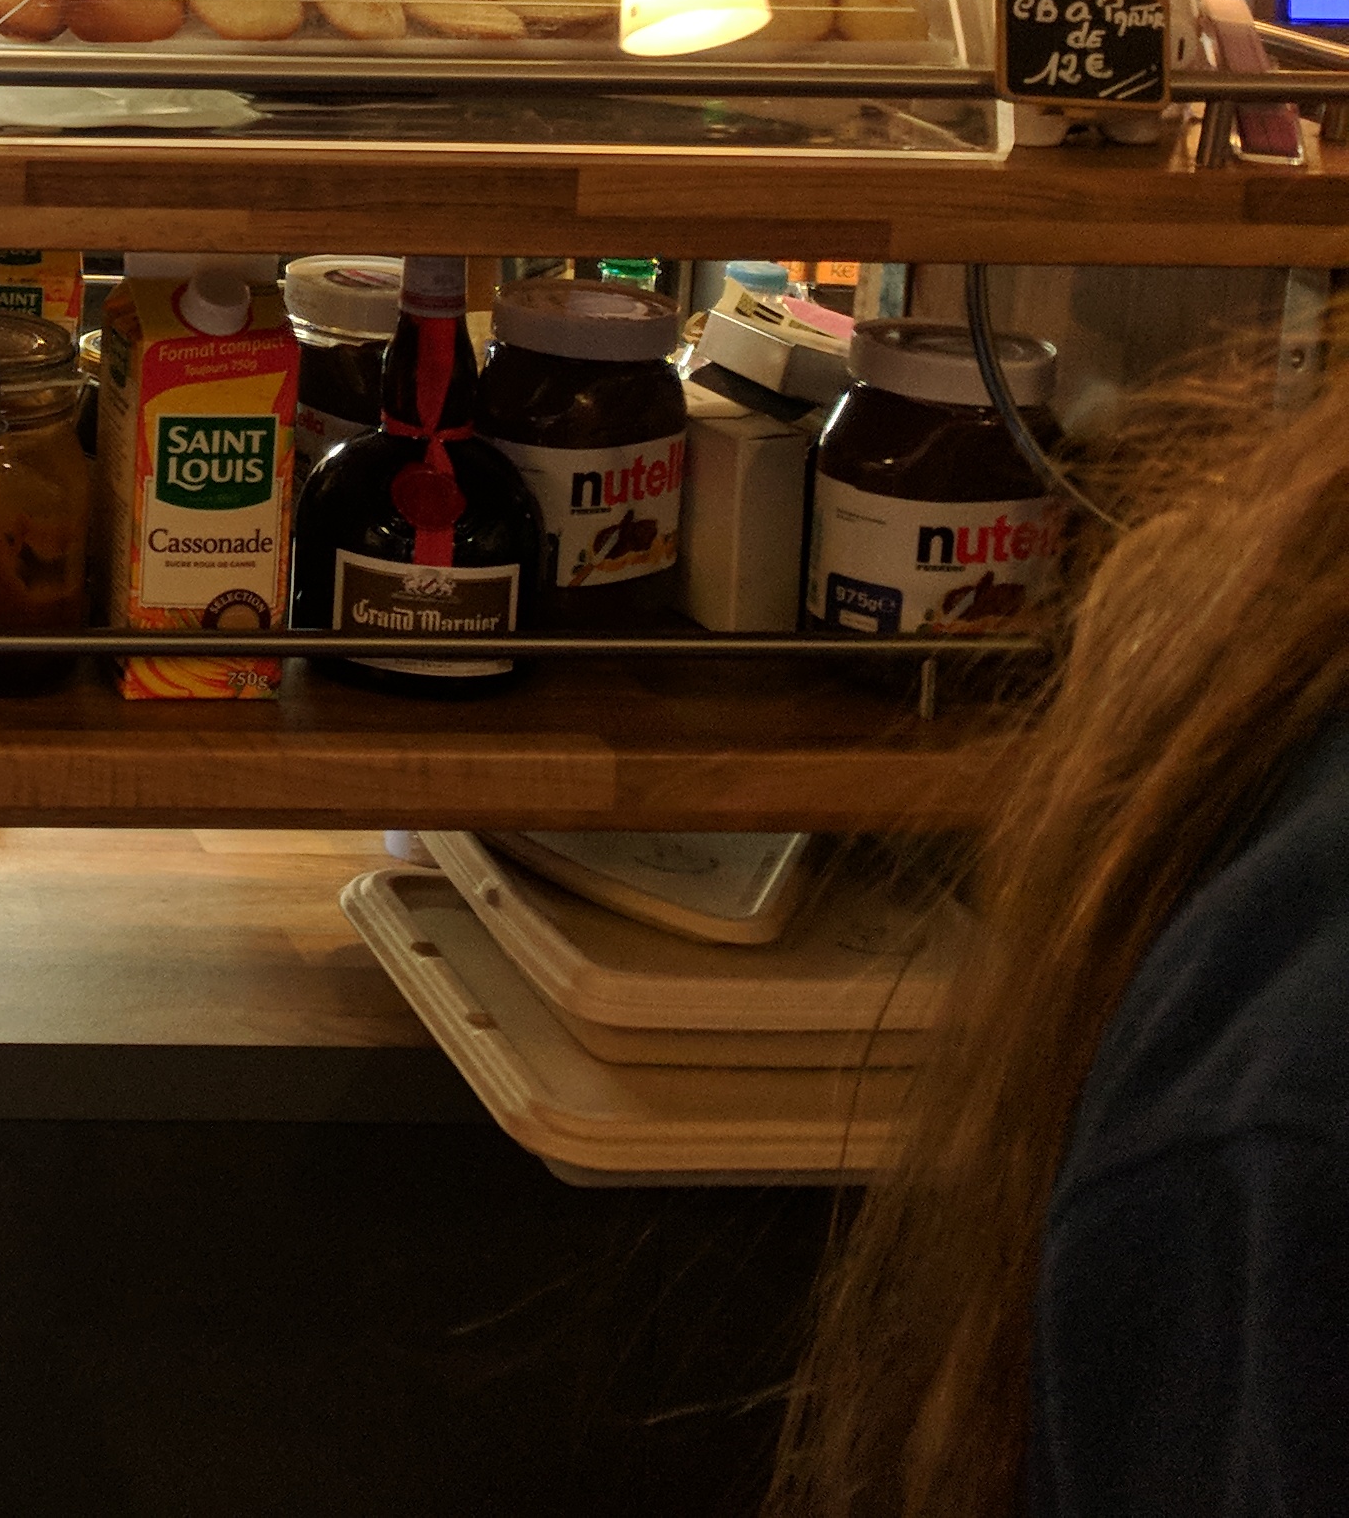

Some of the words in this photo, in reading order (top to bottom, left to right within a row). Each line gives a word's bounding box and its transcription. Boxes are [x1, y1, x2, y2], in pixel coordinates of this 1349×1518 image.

[158, 342, 216, 362] Format
[219, 336, 285, 357] compact
[167, 425, 267, 455] SAINT
[167, 456, 264, 492] LOUIS
[570, 439, 686, 508] nutell
[148, 528, 273, 554] Cassonade
[353, 599, 415, 631] Grand
[416, 609, 500, 632] Marnier
[227, 671, 271, 691] 750g
